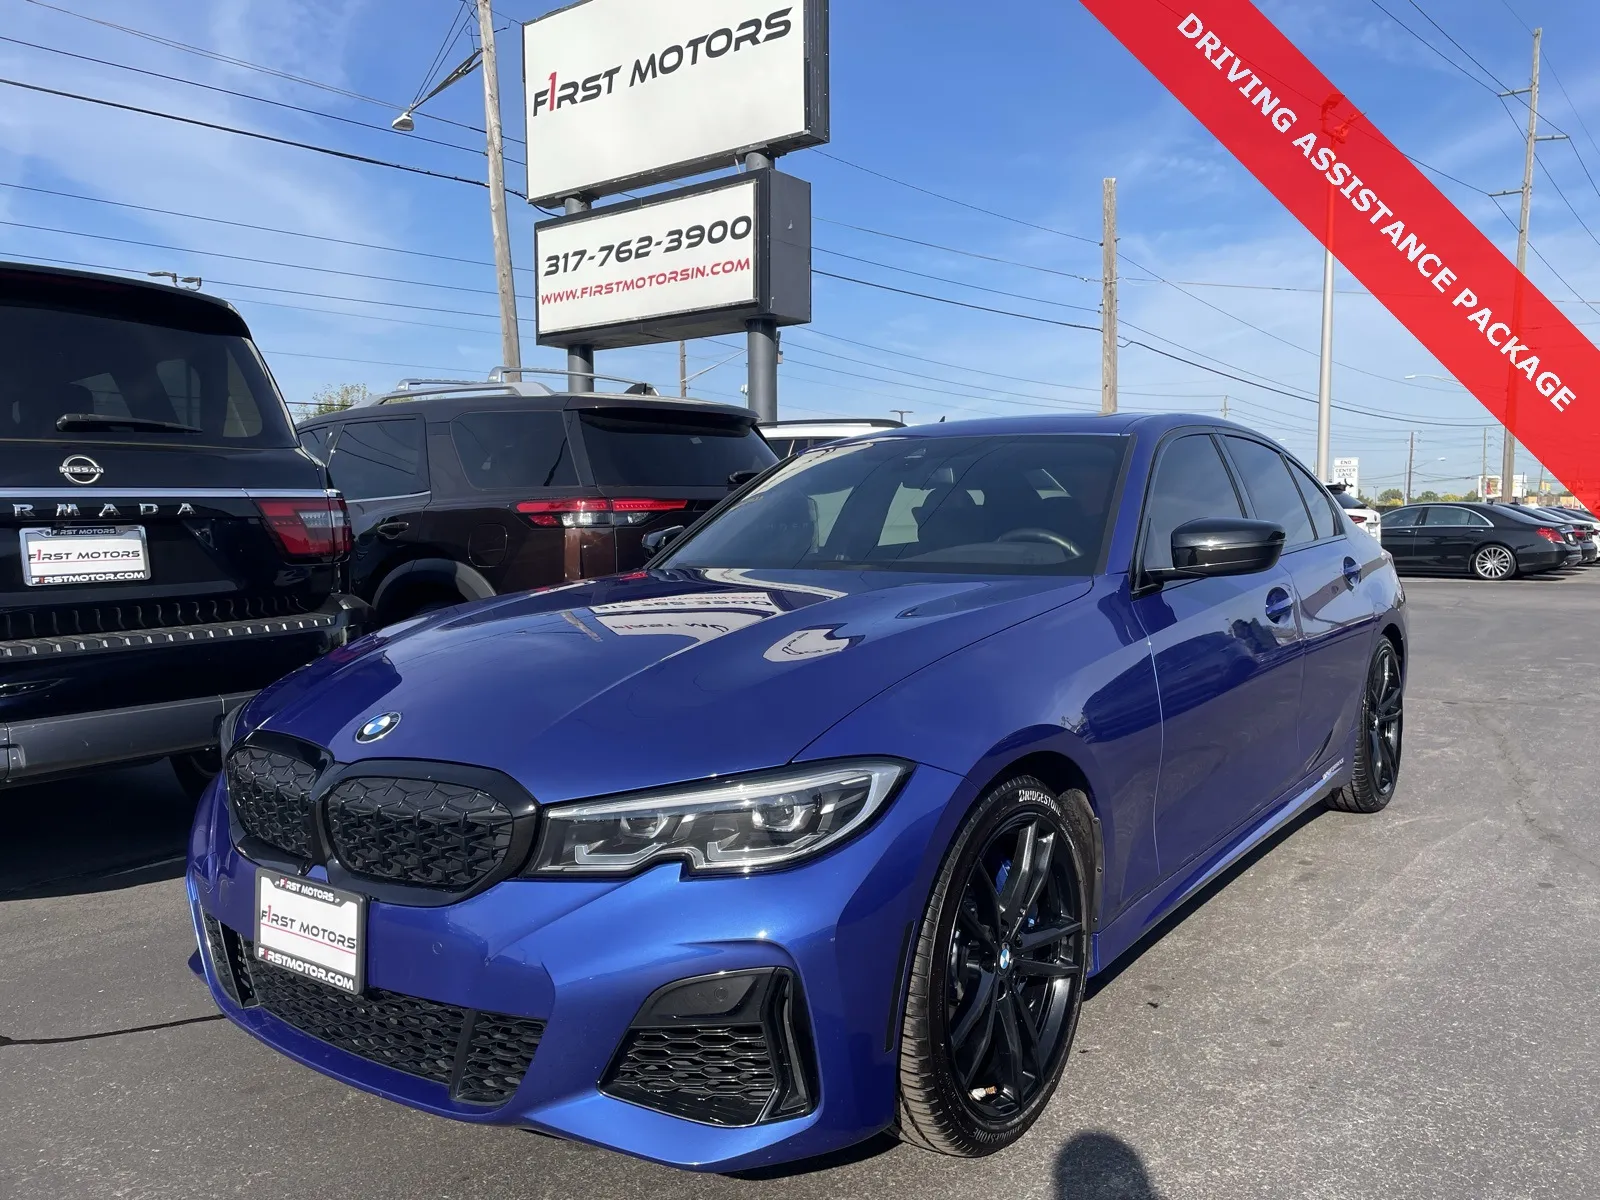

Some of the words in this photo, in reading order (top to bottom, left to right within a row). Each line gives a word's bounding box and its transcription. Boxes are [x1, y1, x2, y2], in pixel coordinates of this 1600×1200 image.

[629, 6, 793, 87] MOTORS
[543, 215, 752, 277] 317-762-3900
[541, 257, 750, 305] WWW.FIRSTMOTORSIN.COM
[60, 466, 104, 474] NISSAN
[76, 550, 140, 560] MOTORS
[301, 885, 335, 902] MOTORS
[299, 921, 356, 949] MOTORS
